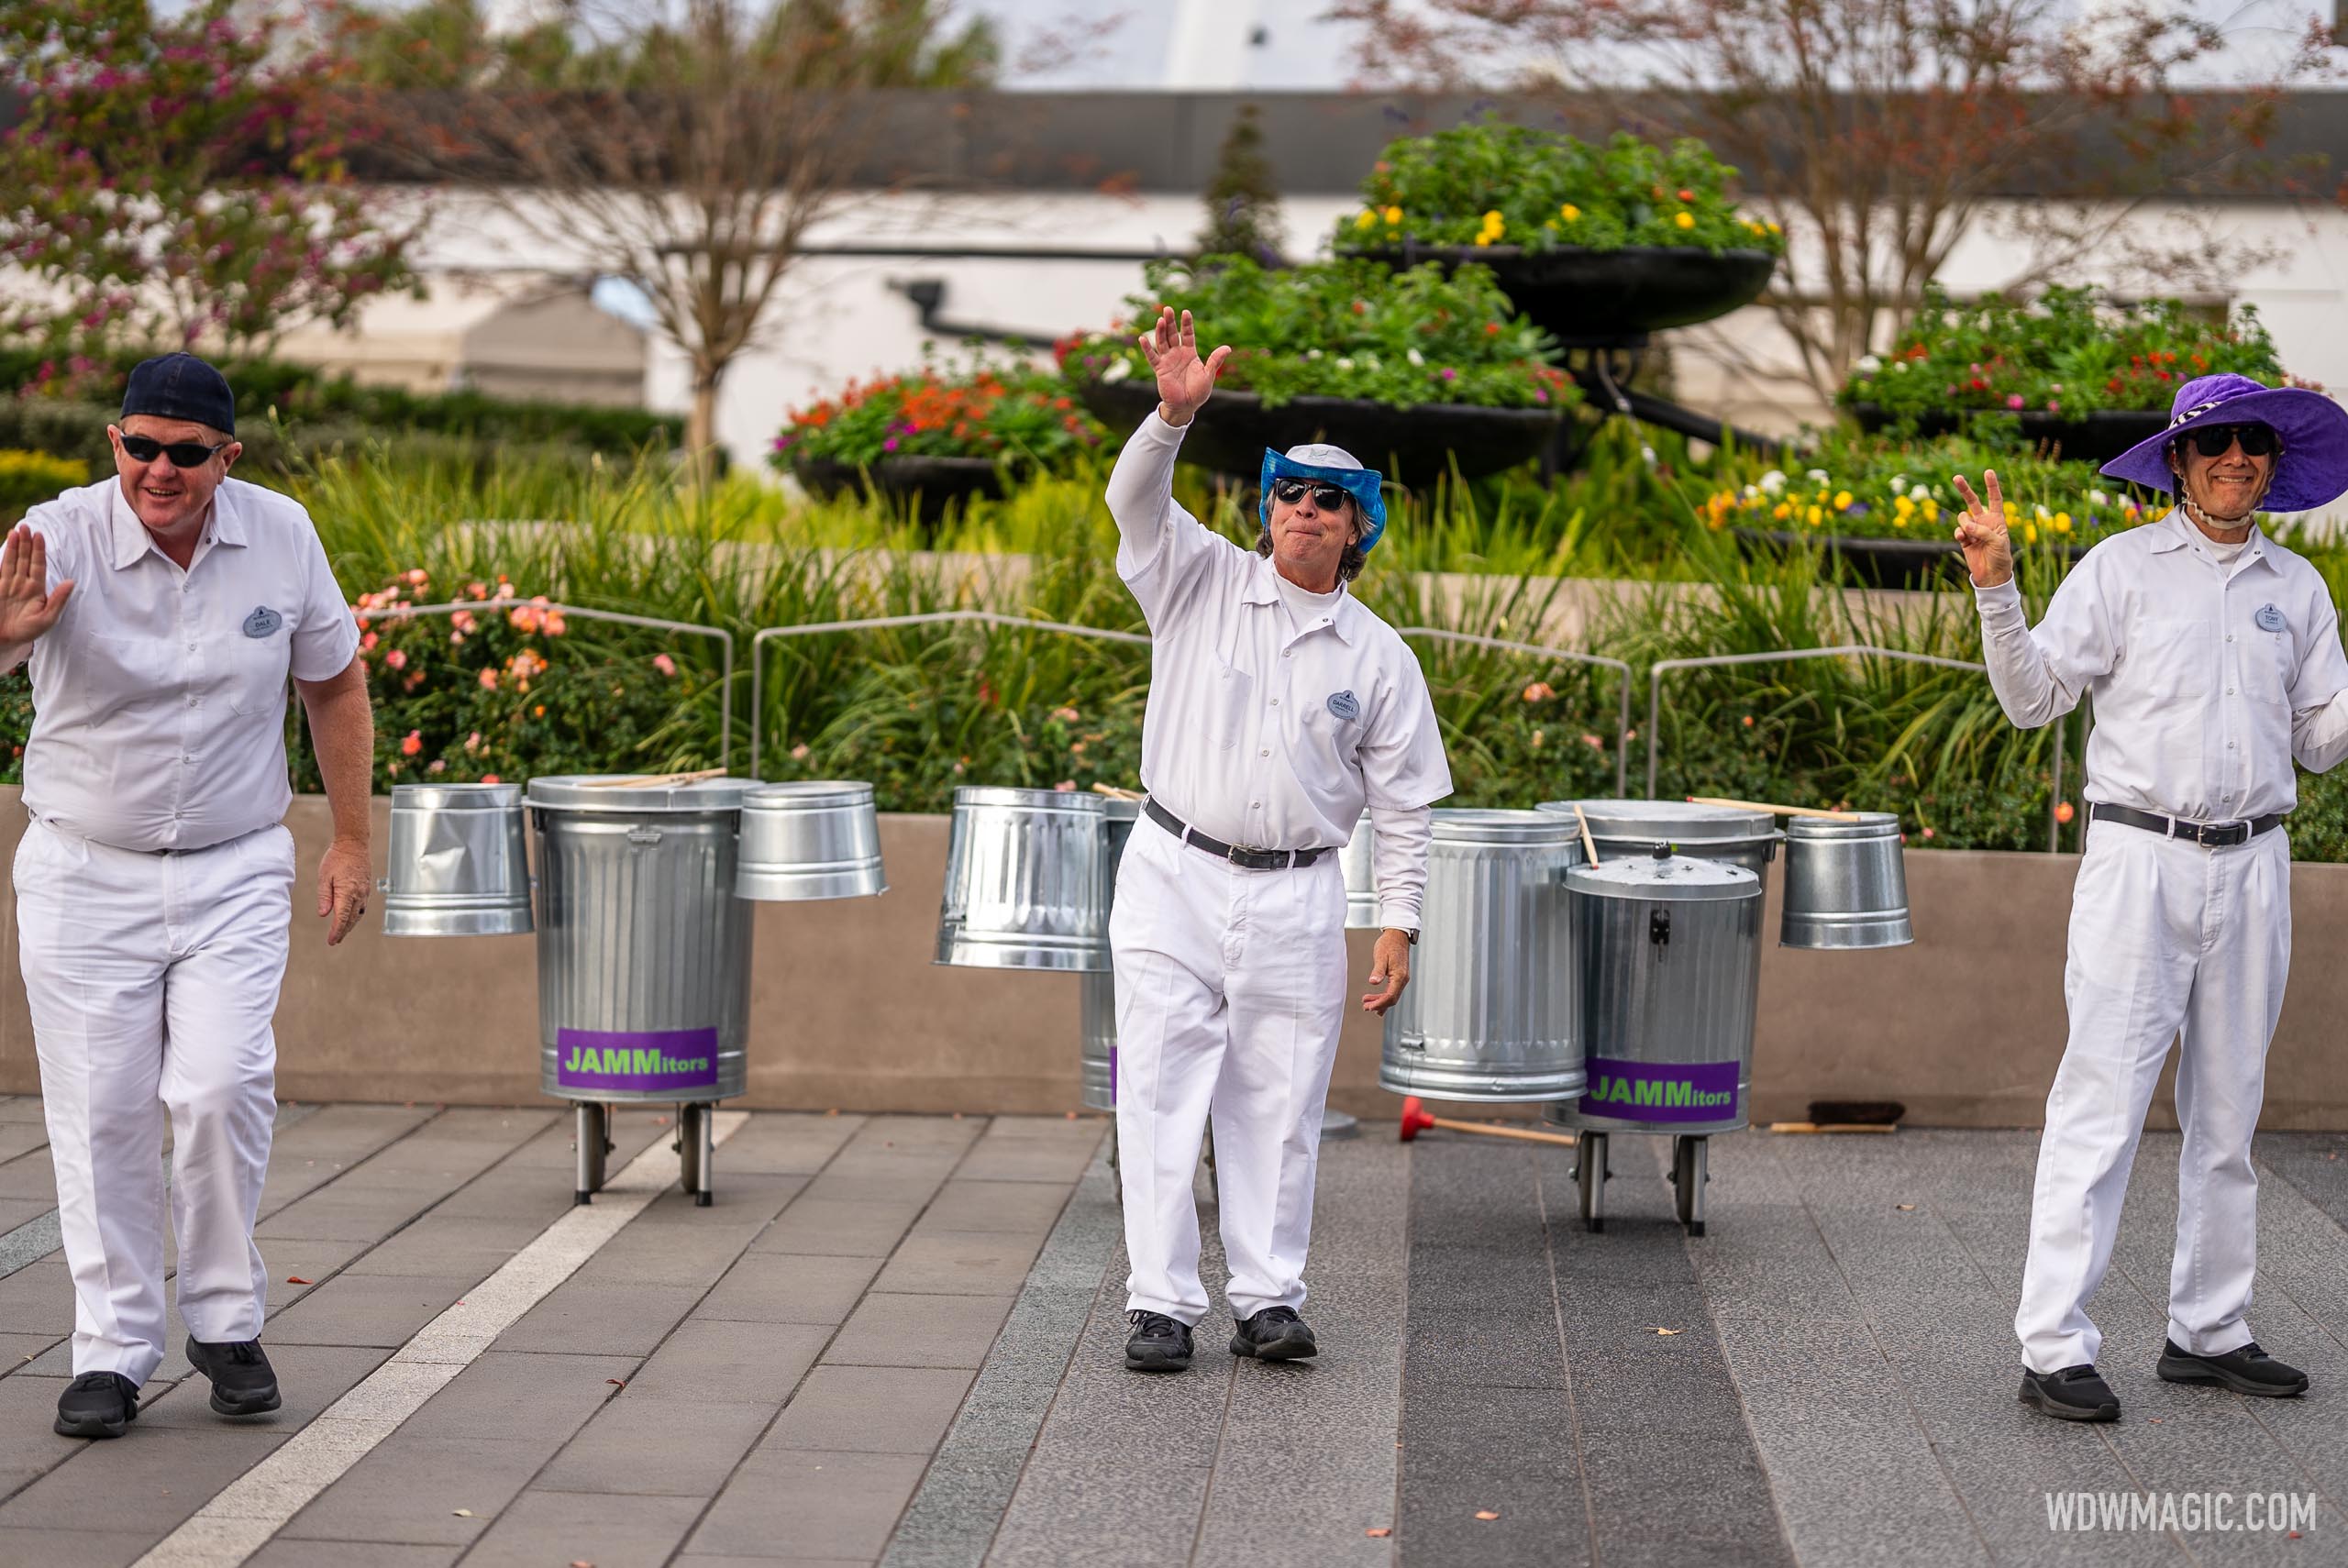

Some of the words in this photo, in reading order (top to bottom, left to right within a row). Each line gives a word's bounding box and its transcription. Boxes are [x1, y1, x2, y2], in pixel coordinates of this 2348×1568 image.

[1332, 699, 1355, 712] DARRELL
[565, 1046, 709, 1075] JAMMitors
[1589, 1076, 1732, 1107] JAMMitors
